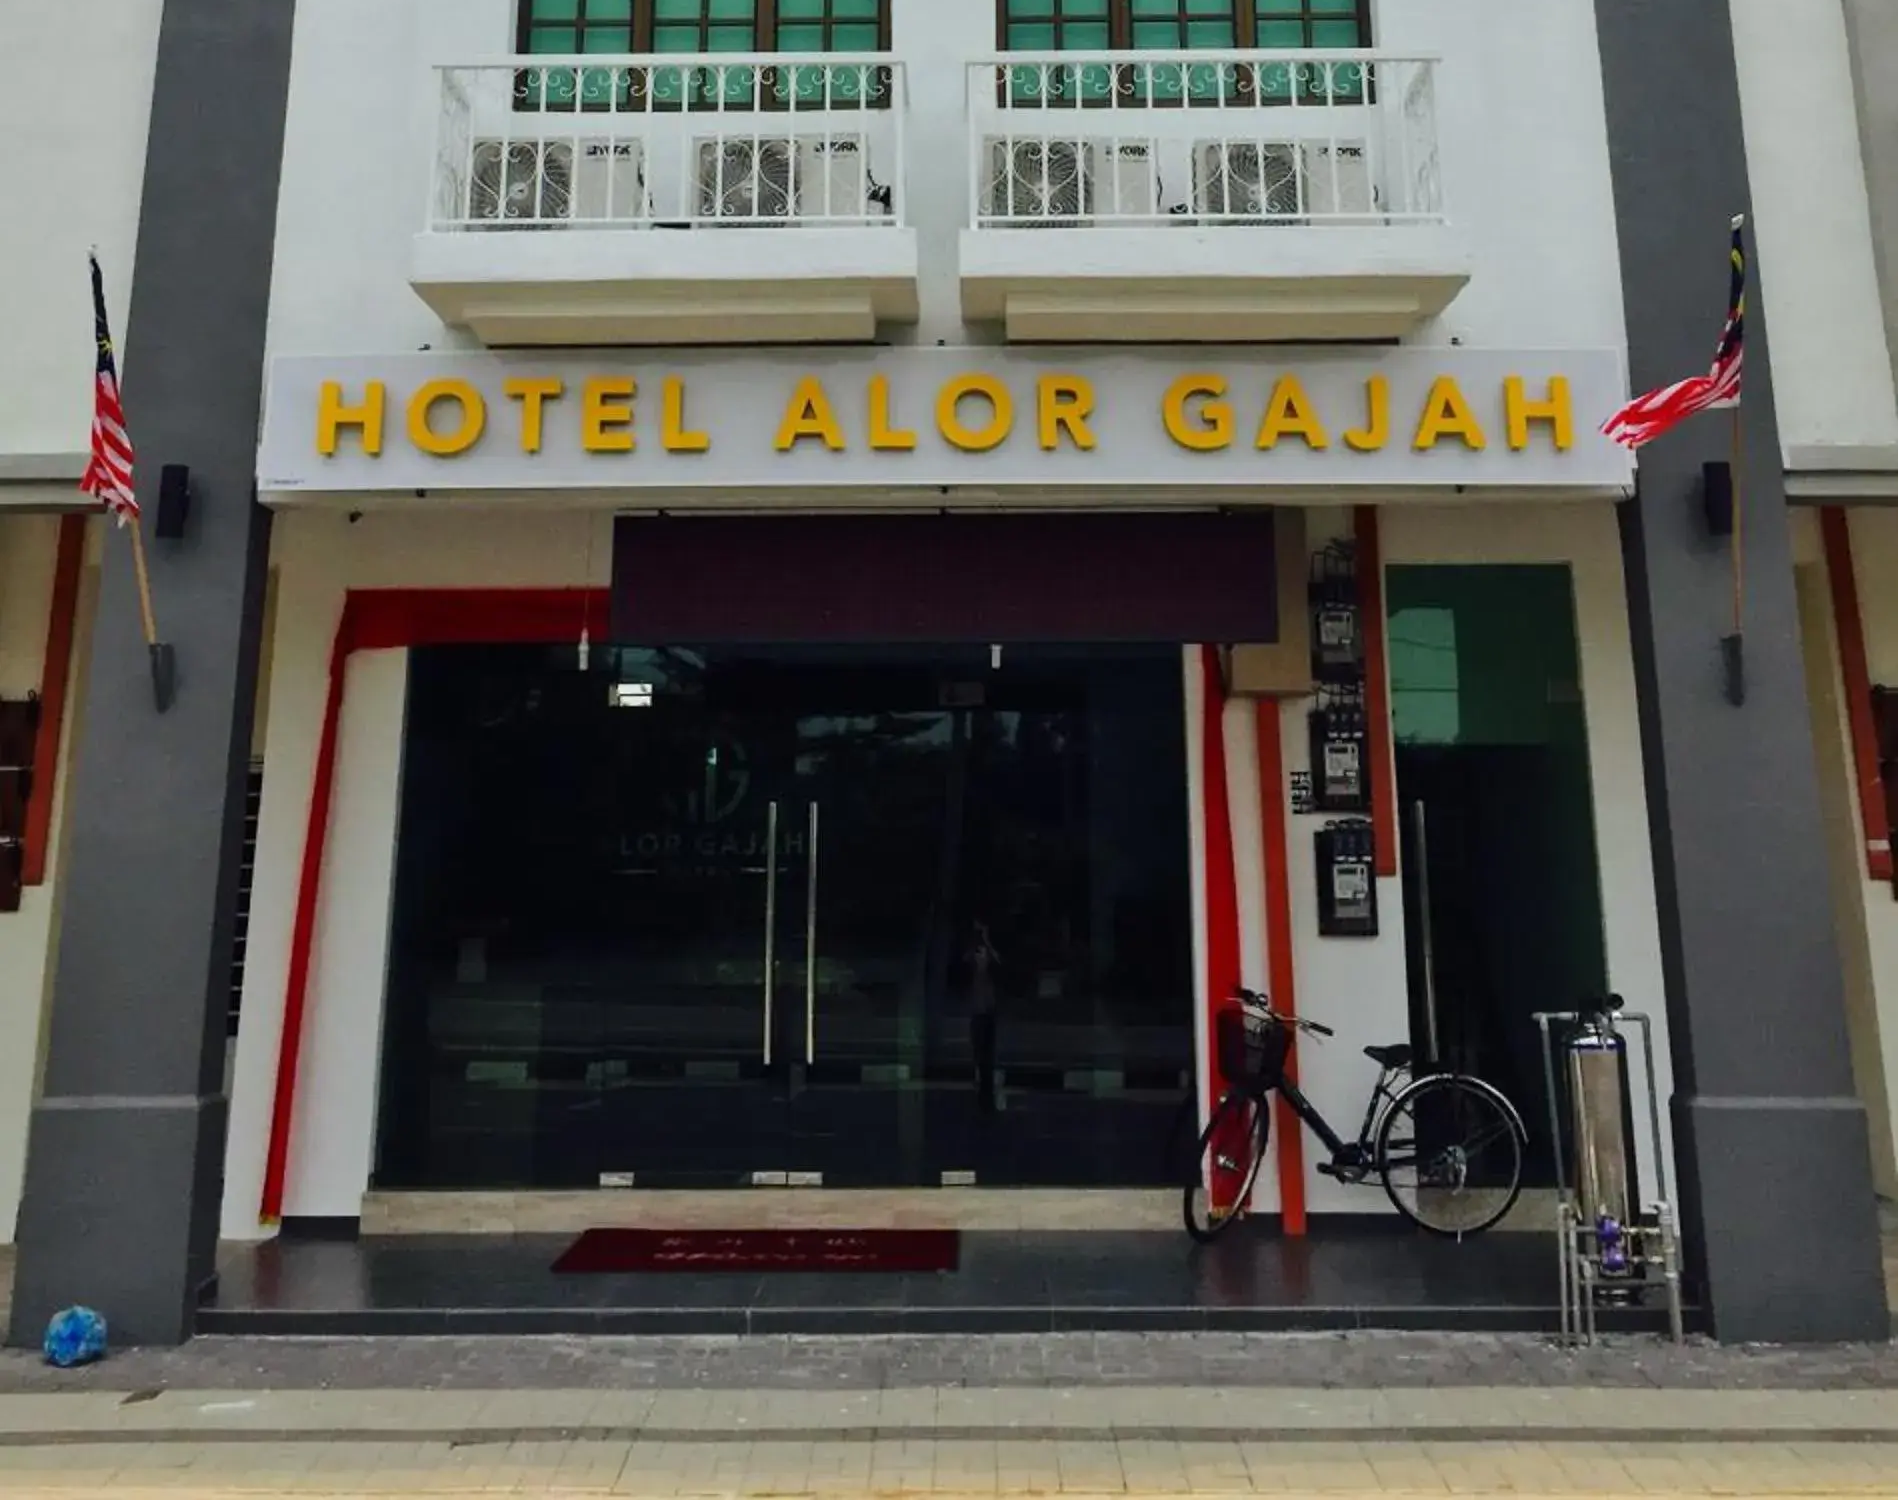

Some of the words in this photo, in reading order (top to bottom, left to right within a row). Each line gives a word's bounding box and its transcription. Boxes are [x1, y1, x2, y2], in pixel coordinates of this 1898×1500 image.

[317, 376, 709, 456] HOTEL
[774, 374, 1094, 451] ALOR
[1163, 373, 1574, 452] GAJAH
